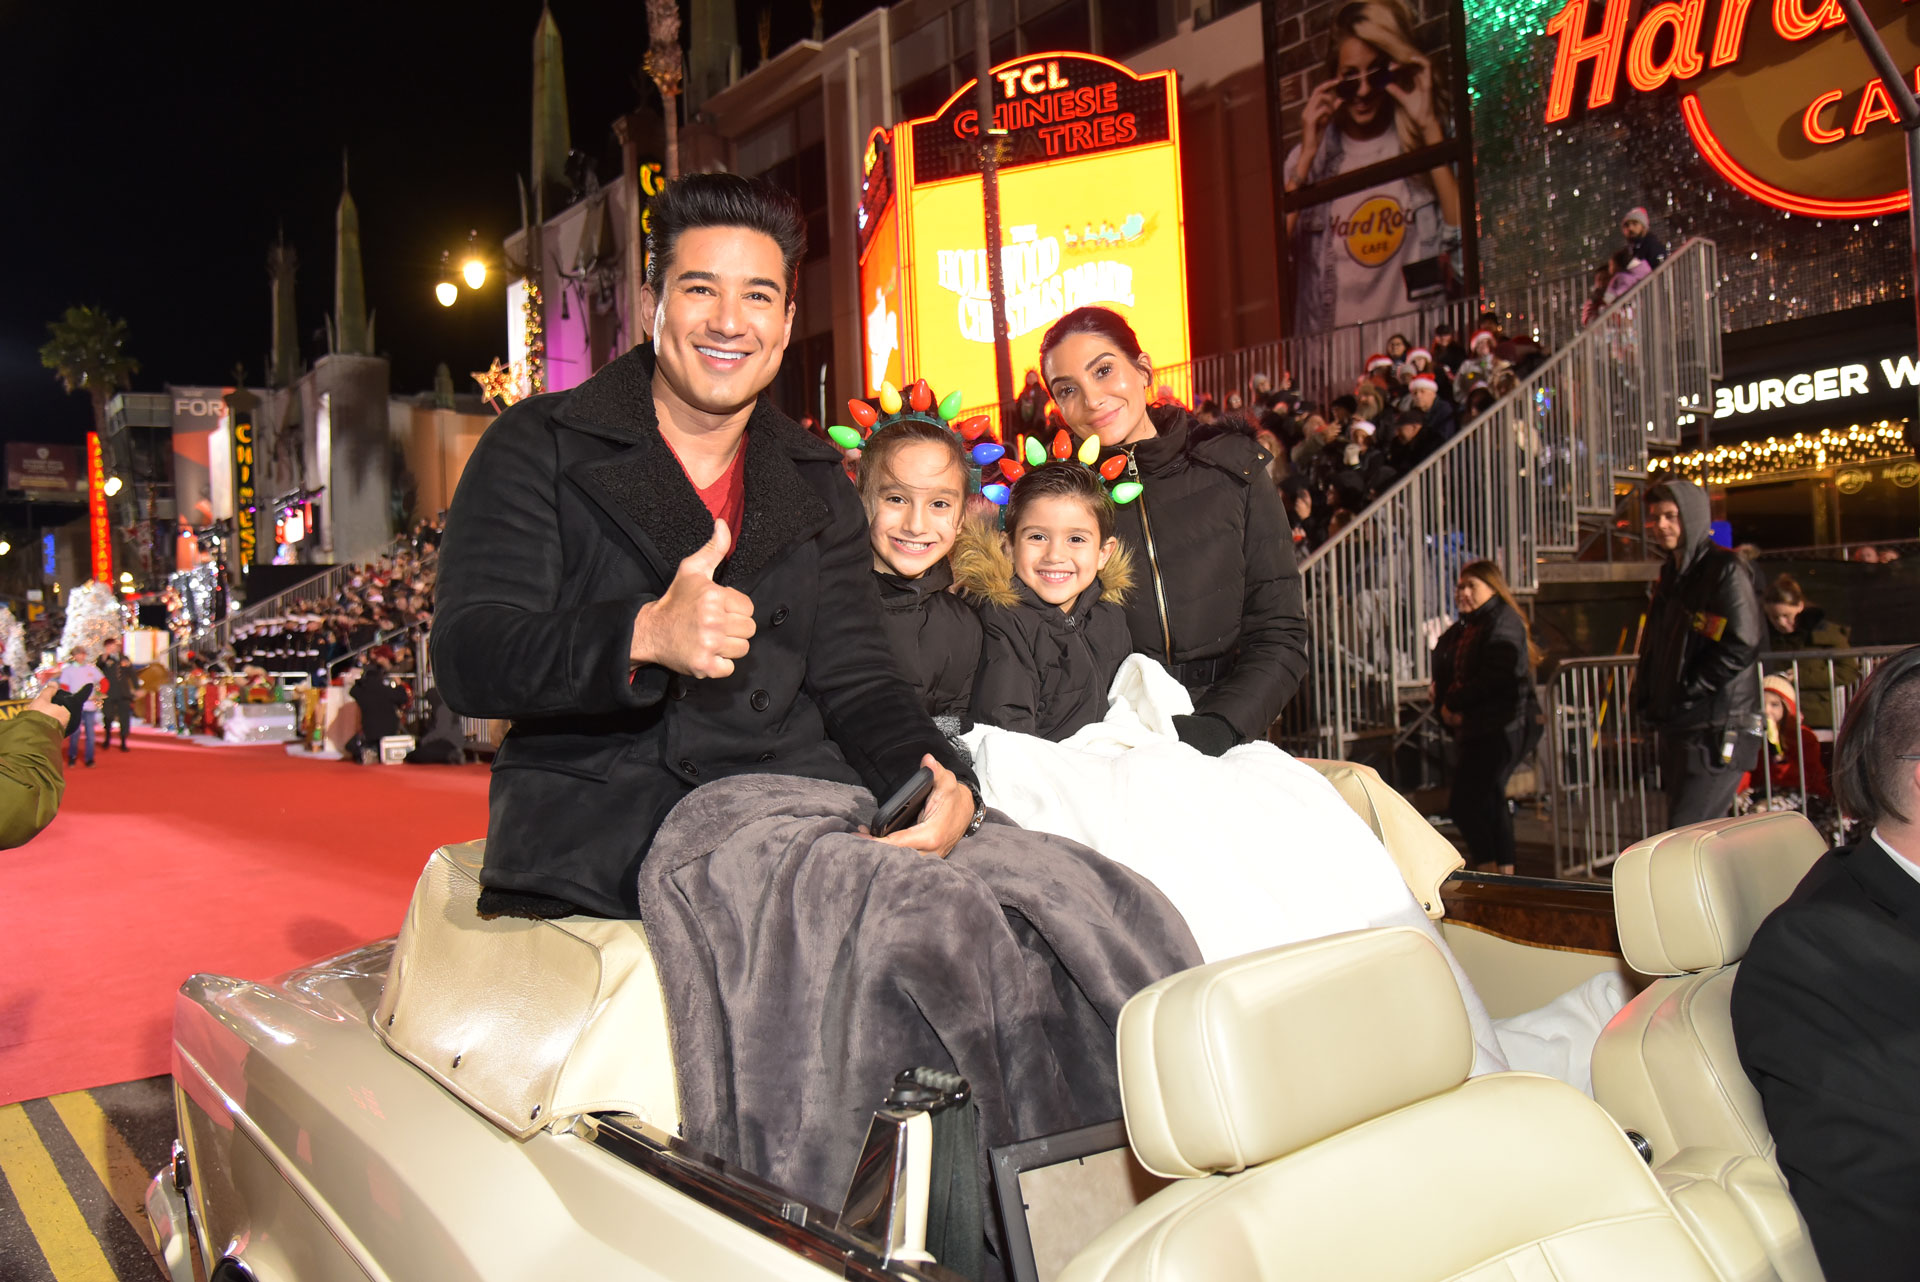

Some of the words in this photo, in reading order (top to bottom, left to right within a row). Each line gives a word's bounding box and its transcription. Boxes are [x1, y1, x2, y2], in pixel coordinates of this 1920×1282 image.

[996, 60, 1069, 98] TCL
[1802, 66, 1920, 144] CA
[1329, 211, 1375, 237] Hard
[1362, 241, 1389, 255] CAFE
[937, 236, 1060, 300] HOLLWOOD
[958, 275, 1064, 342] CHSTMAS
[1713, 363, 1869, 419] BURGER
[96, 506, 109, 582] TUSSAUD
